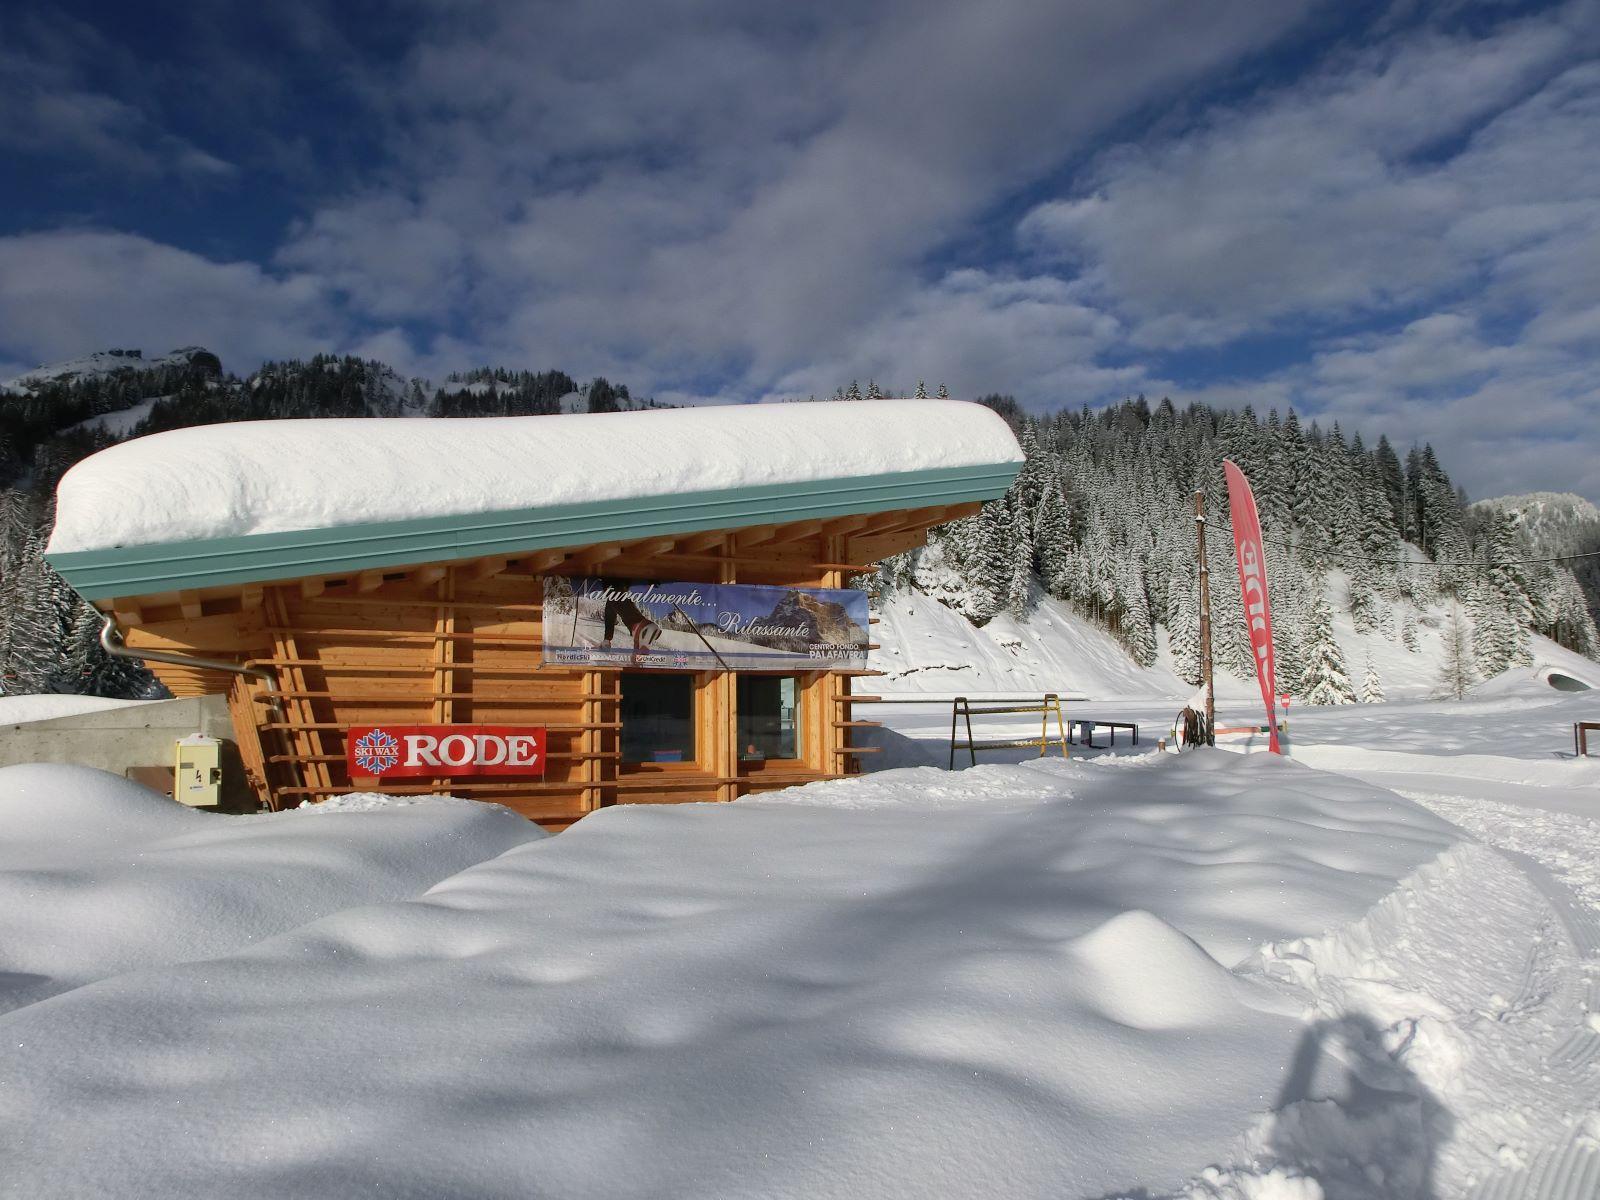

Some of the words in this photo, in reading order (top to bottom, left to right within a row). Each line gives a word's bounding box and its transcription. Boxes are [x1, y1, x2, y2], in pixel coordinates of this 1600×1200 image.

[717, 611, 810, 638] Rilassante
[809, 650, 864, 659] PALAFAVERA
[354, 747, 373, 756] SKI
[374, 747, 399, 756] WAX
[403, 734, 538, 767] RODE
